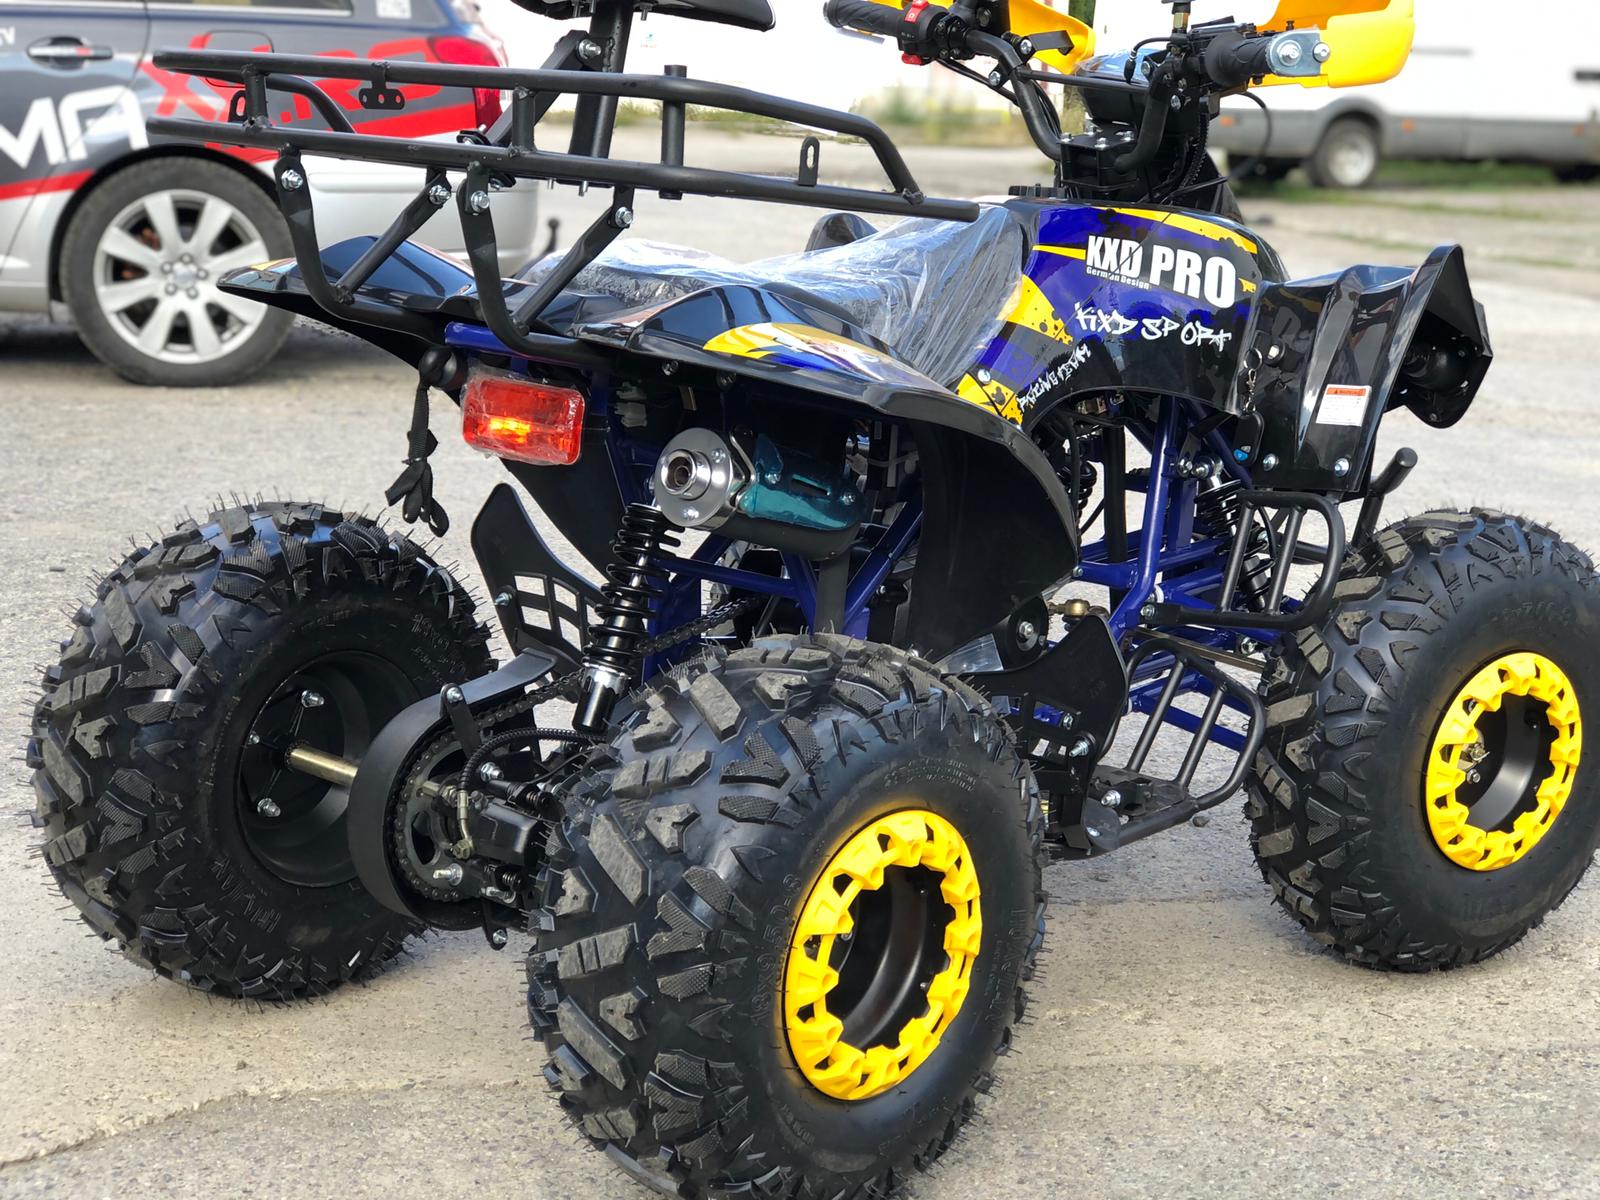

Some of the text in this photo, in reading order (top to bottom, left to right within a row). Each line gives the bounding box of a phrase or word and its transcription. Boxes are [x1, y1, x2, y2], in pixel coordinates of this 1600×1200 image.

[1086, 235, 1237, 309] KXD PRO
[1086, 266, 1150, 290] German Design
[1074, 301, 1139, 335] KXD
